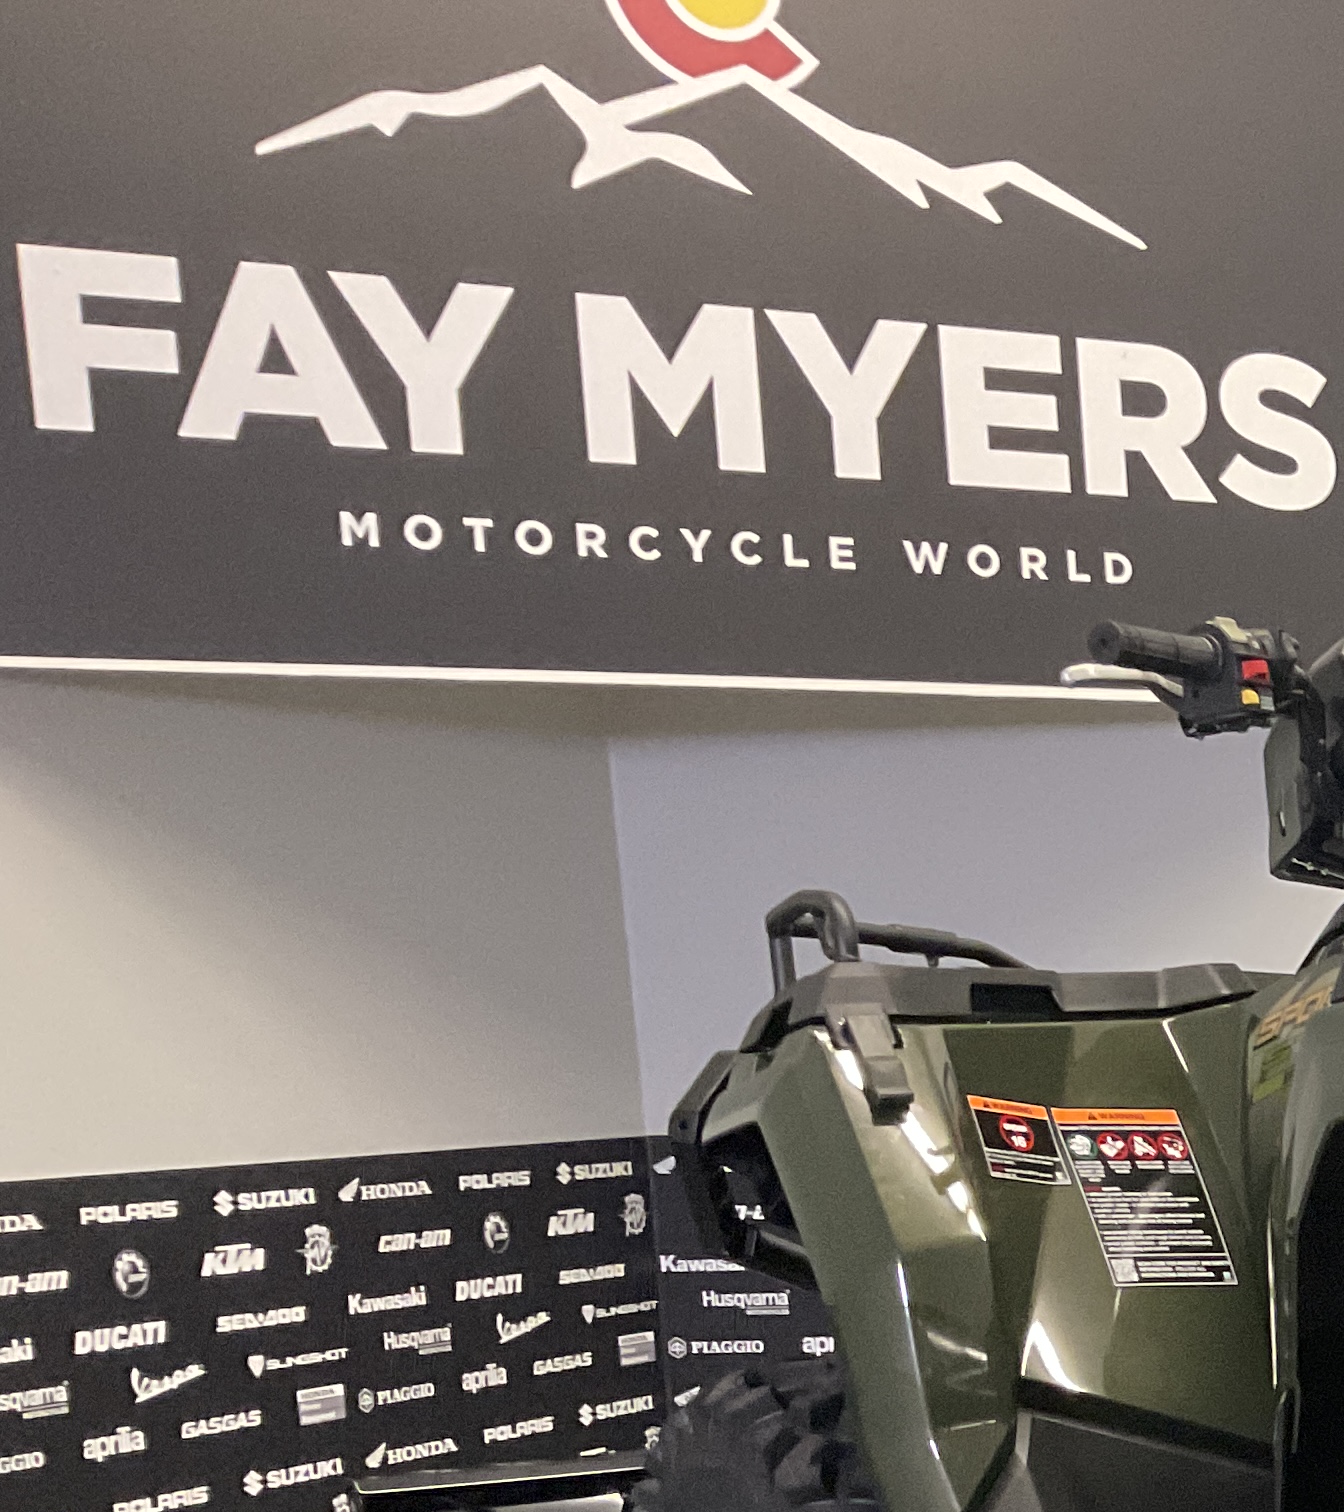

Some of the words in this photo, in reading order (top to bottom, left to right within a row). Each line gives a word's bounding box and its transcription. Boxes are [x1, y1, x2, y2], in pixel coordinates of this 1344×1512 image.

[16, 243, 514, 455] FAY
[575, 293, 1336, 511] MYERS
[340, 511, 856, 570] MOTORCYCLE
[903, 540, 1132, 584] WORLD
[459, 1171, 530, 1191] POLARIS
[574, 1161, 632, 1180] SUZUKI
[237, 1188, 316, 1210] SUZUKI
[360, 1181, 432, 1200] HONDA
[80, 1201, 178, 1225] POLARIS
[548, 1208, 594, 1236] KTM
[378, 1229, 451, 1252] can-am
[201, 1243, 265, 1276] KTM
[659, 1255, 745, 1272] Kawas
[348, 1286, 426, 1314] Kawasaki
[456, 1274, 522, 1301] DUCATI
[702, 1291, 788, 1308] Husqvarna
[75, 1321, 166, 1354] DUCATI
[383, 1323, 452, 1350] Husqvarna
[691, 1340, 764, 1353] PIAGGIO
[533, 1352, 592, 1375] GASGAS
[462, 1363, 507, 1393] aprilia
[0, 1385, 68, 1411] sqvarna
[377, 1383, 434, 1405] PIAGGIO
[596, 1396, 653, 1419] SUZUKI
[182, 1410, 261, 1438] GASGAS
[484, 1417, 553, 1443] POLARIS
[83, 1426, 145, 1462] aprilia
[386, 1439, 458, 1464] HONDA
[0, 1452, 44, 1473] GGIO
[266, 1458, 343, 1488] SUZUKI
